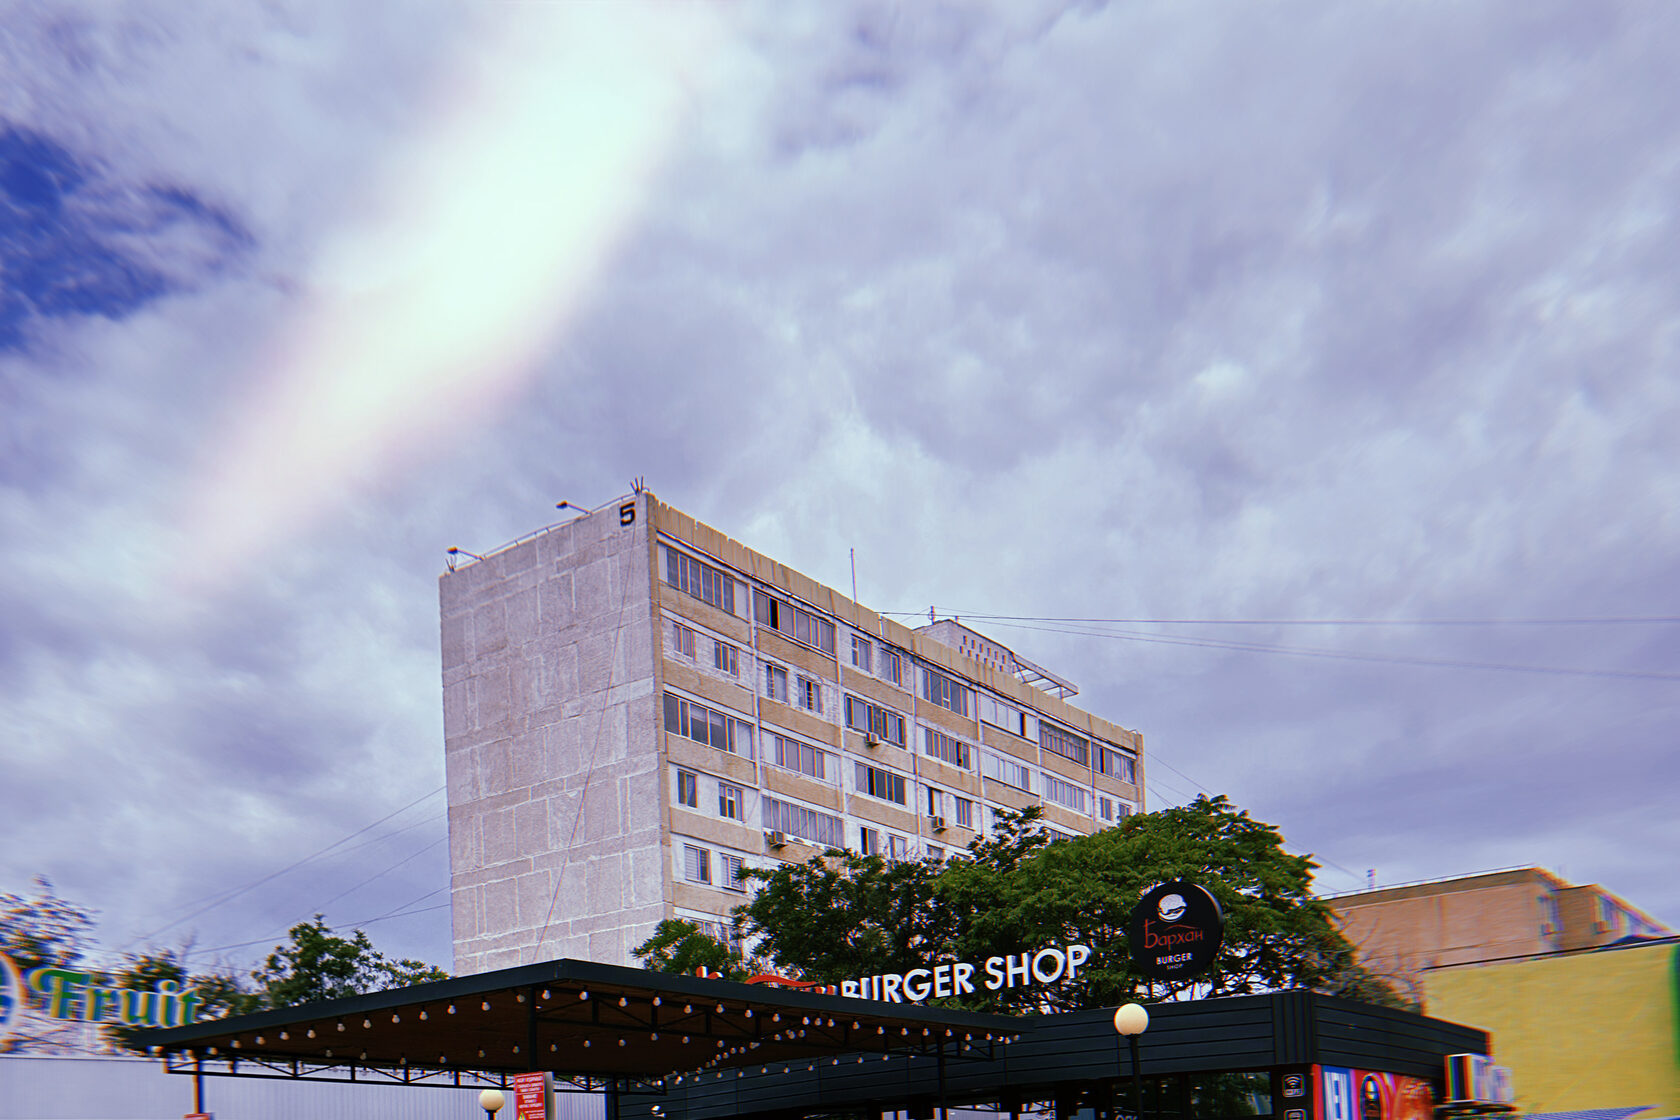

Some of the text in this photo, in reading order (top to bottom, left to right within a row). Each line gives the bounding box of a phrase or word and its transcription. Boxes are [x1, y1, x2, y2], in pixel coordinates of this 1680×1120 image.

[620, 501, 636, 527] 5
[841, 963, 975, 1003] BURGER
[984, 945, 1091, 990] SHOP
[1156, 952, 1193, 965] BURGER
[28, 967, 206, 1029] Fruit
